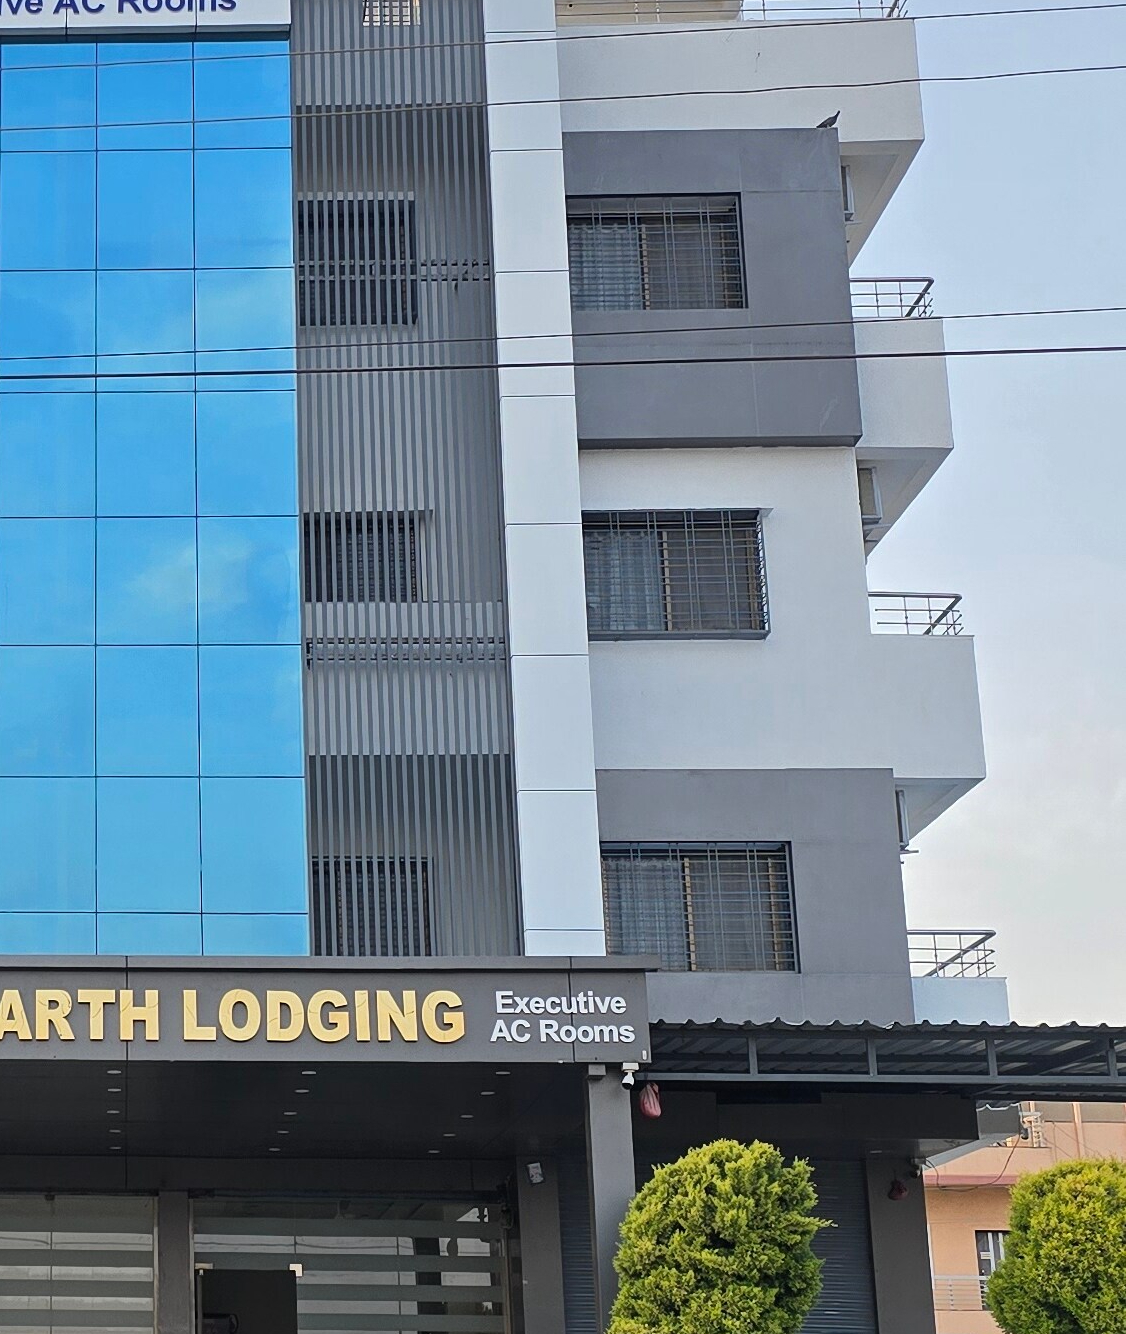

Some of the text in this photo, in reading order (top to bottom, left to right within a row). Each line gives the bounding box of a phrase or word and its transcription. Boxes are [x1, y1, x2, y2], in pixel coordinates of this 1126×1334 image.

[495, 990, 627, 1014] Executive
[183, 988, 466, 1043] LODGING
[490, 1019, 636, 1043] AC Rooms
